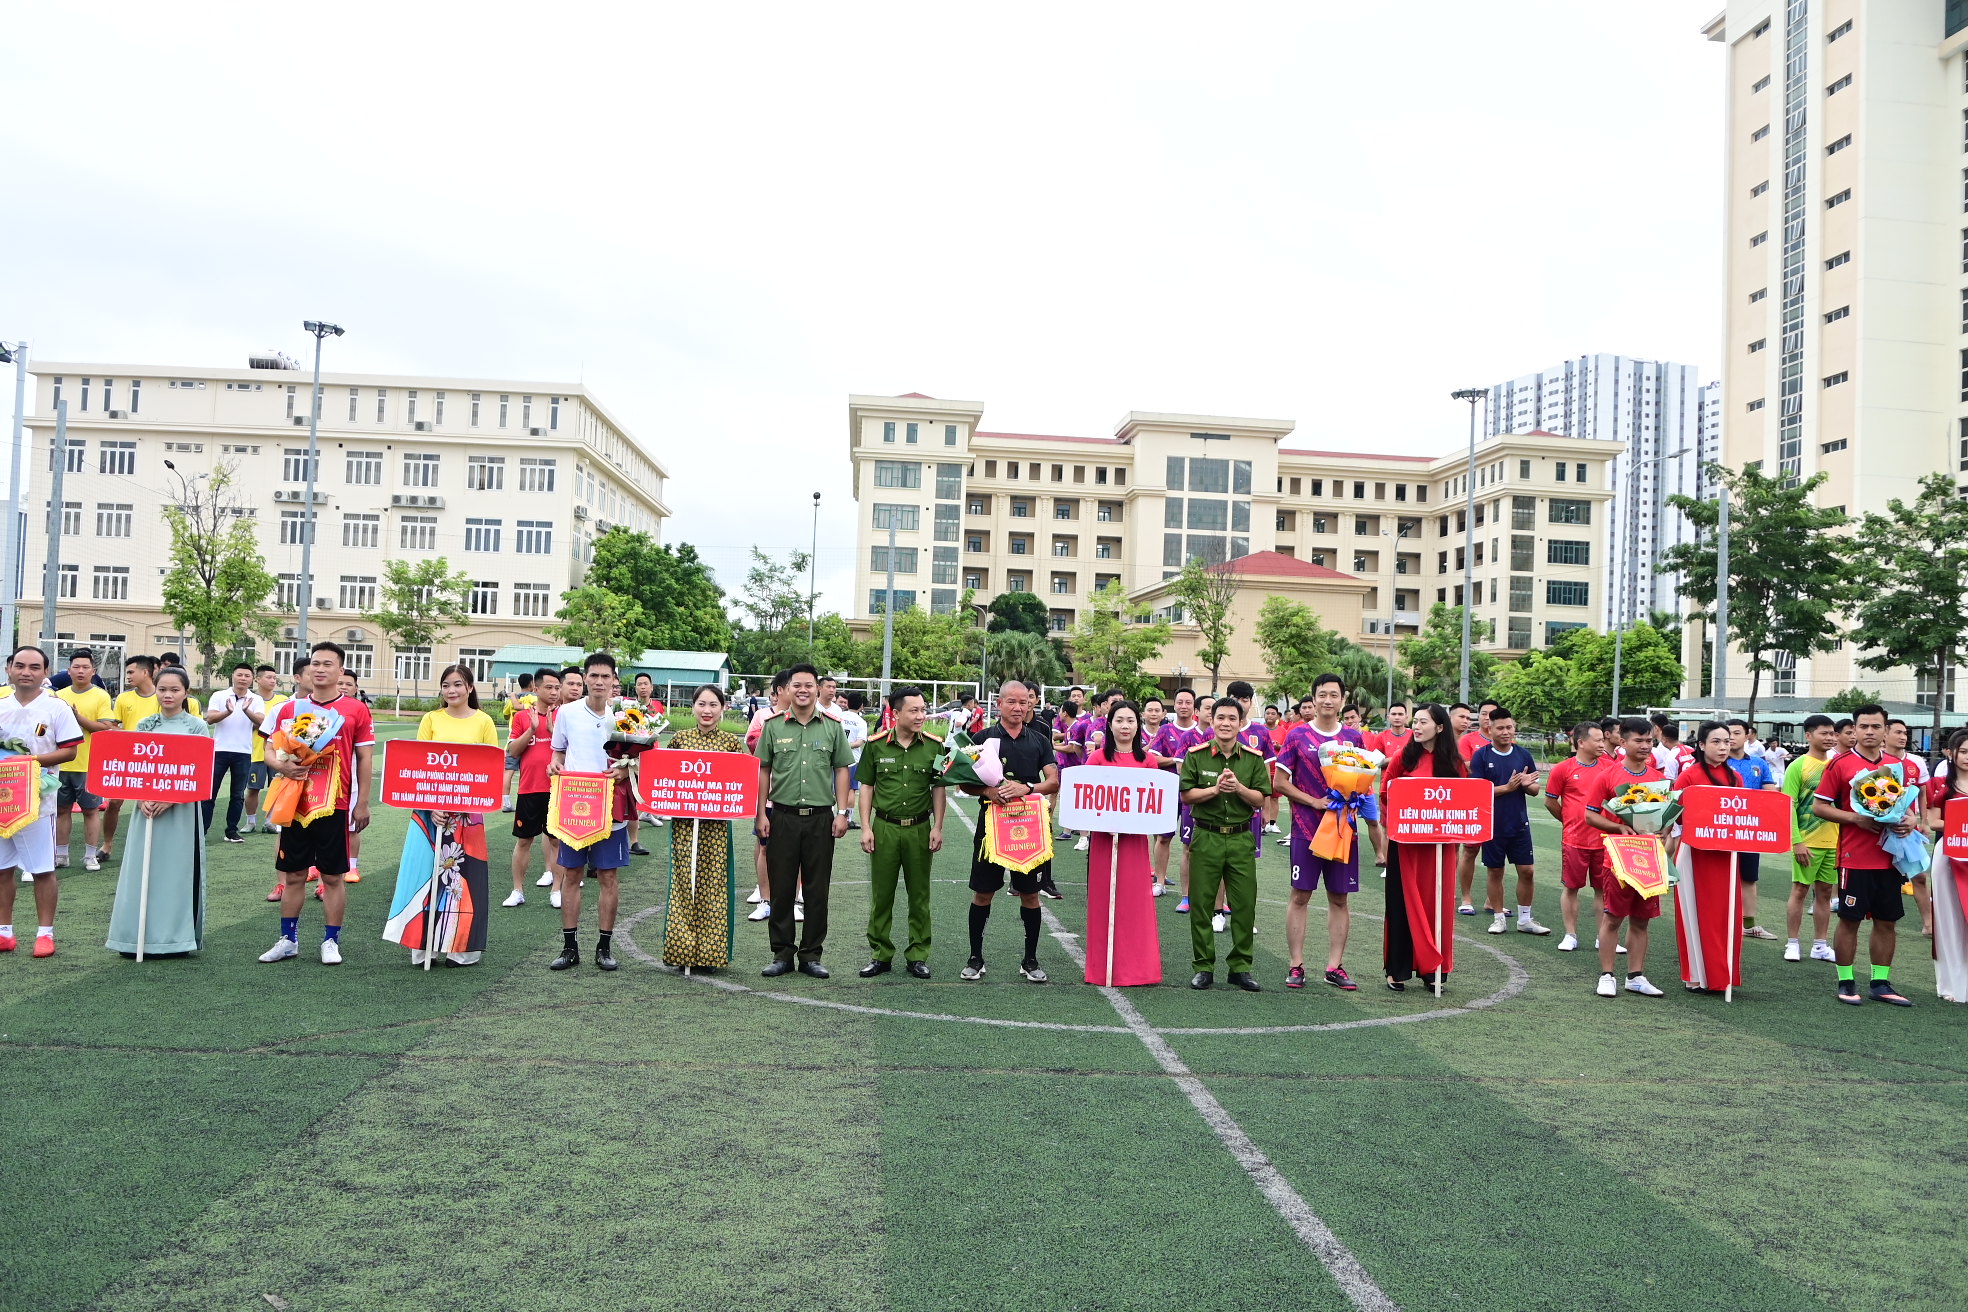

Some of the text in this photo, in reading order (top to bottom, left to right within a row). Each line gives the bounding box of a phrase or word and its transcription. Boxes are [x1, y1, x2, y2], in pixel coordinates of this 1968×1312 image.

[133, 741, 164, 759] ĐỘI
[427, 750, 458, 769] ĐỘI
[103, 759, 196, 776] LIÊN QUÂN VẠN MỸ
[680, 758, 712, 777] ĐỘI
[126, 777, 143, 788] TRE
[152, 778, 171, 792] LẠC
[174, 778, 196, 791] VIÊN
[251, 773, 257, 783] 3
[654, 778, 676, 788] LIÊN
[678, 779, 704, 789] QUÂN
[707, 782, 723, 790] MA
[676, 790, 694, 800] TRA
[724, 793, 744, 804] HỢP
[1074, 782, 1163, 816] TRỌNG TÀI
[1424, 786, 1452, 804] ĐỘI
[651, 800, 680, 810] CHÍNH
[683, 802, 699, 812] TRỊ
[701, 802, 720, 813] HẬU
[1720, 795, 1748, 812] ĐỘI
[1400, 807, 1479, 820] LIÊN QUÂN KINH TẾ
[1714, 813, 1759, 826] LIÊN QUÂN
[1183, 826, 1191, 838] 2
[1398, 823, 1410, 834] AN
[1412, 824, 1433, 834] NINH
[1465, 824, 1482, 836] HỢP
[1696, 826, 1714, 838] MÁY
[1717, 828, 1728, 839] TƠ
[1735, 828, 1755, 840] MÁY
[1757, 831, 1777, 842] CHAI
[1292, 865, 1300, 880] 8
